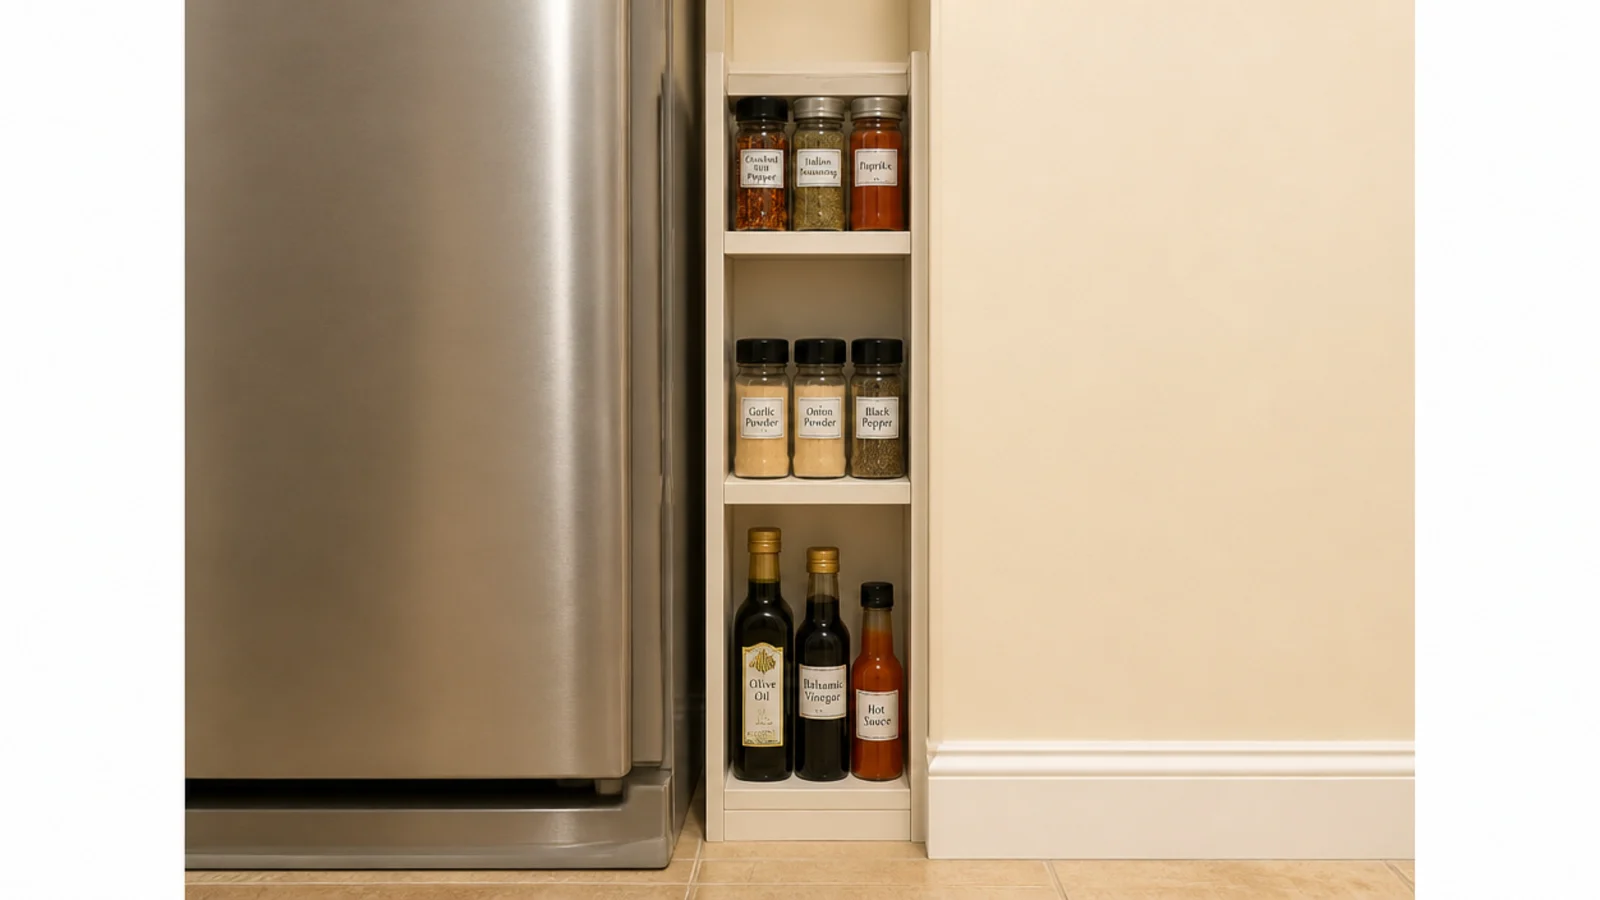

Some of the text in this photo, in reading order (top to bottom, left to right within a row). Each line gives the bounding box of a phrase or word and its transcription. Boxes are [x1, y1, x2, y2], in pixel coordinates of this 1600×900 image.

[748, 407, 775, 416] Garlic
[806, 405, 833, 416] Onion
[865, 407, 890, 416] Black
[749, 679, 776, 689] Olive
[754, 691, 770, 701] Oil
[804, 691, 841, 704] Vinegar
[868, 704, 885, 715] Hot
[864, 716, 892, 726] Sauce
